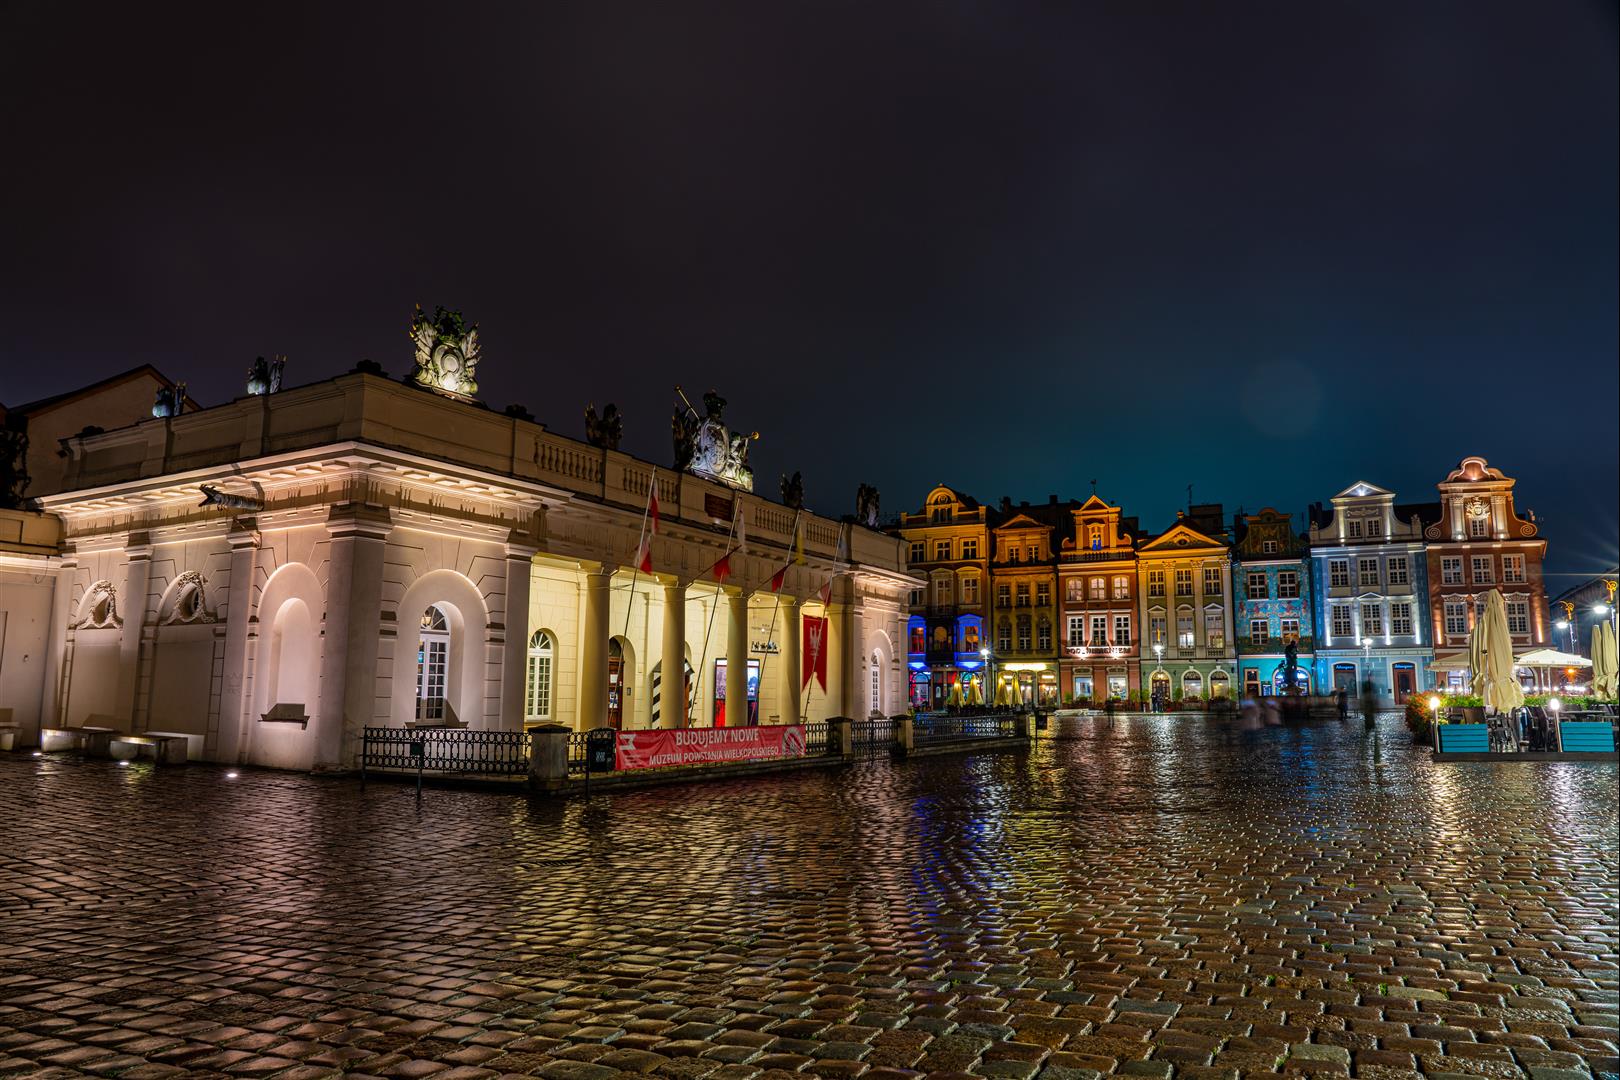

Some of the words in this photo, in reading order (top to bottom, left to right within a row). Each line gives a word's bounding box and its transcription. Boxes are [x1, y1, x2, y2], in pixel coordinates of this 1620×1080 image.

[676, 729, 730, 748] BUDUJEMY
[731, 728, 759, 742] NOWE
[649, 753, 682, 765] MUZEUM
[684, 750, 723, 763] POWSTANIA
